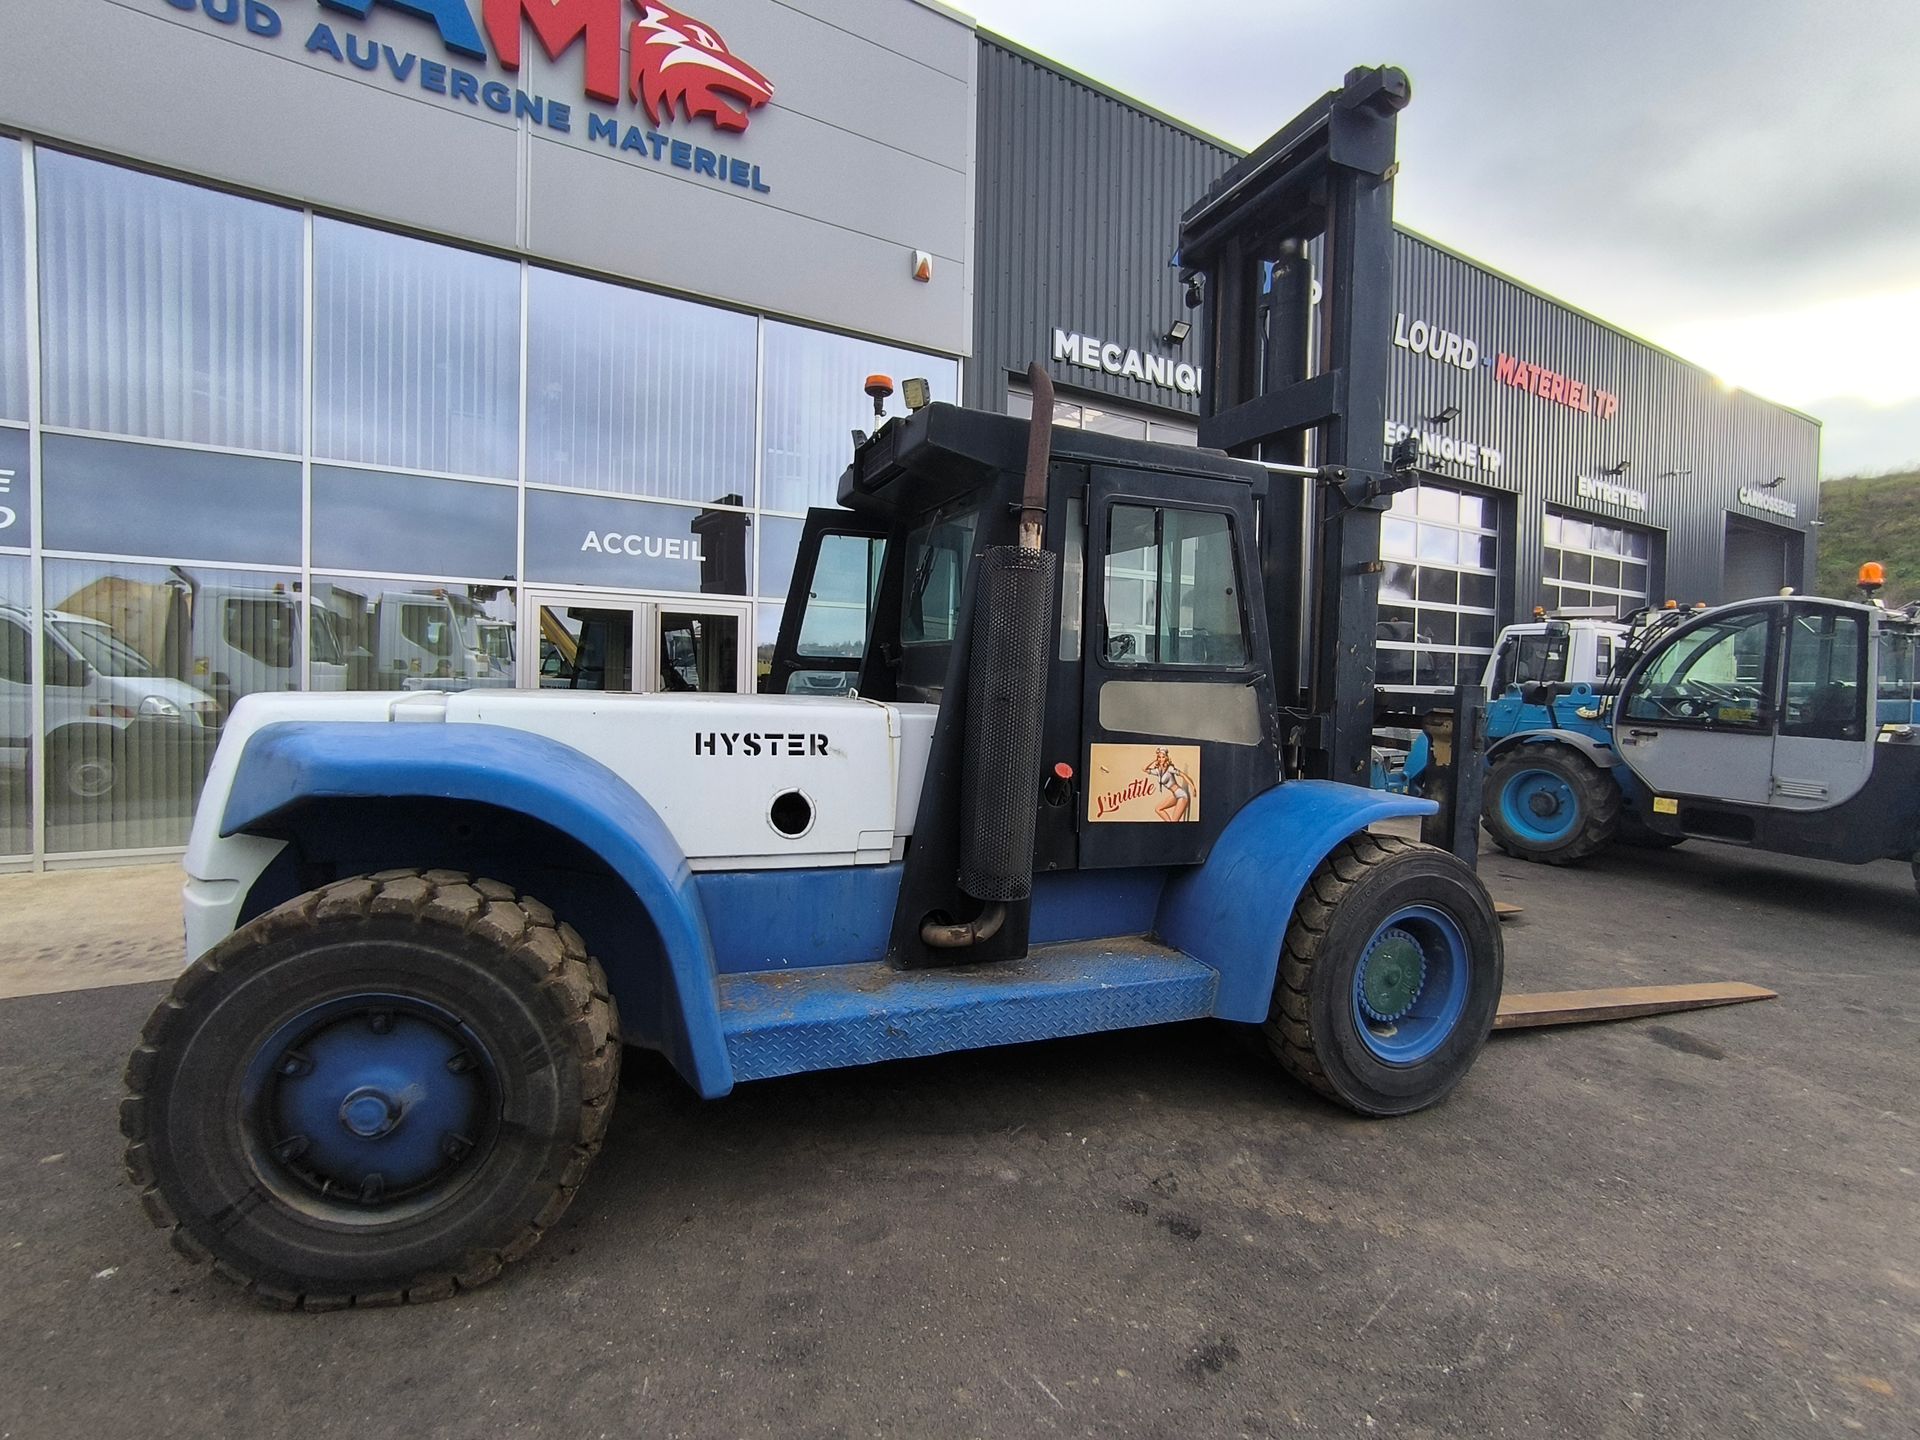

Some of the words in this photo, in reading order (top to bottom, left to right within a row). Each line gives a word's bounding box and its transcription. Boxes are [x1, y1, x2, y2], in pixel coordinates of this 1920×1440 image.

[305, 22, 571, 132] AUVERGNE
[588, 111, 771, 194] MATERIEL
[1394, 312, 1478, 370] LOURD
[1495, 352, 1589, 413] MATERIEL
[1595, 389, 1617, 420] TP
[1479, 446, 1502, 473] TP
[1578, 475, 1648, 512] ENTRETIEN
[581, 530, 707, 562] ACCUEIL
[695, 732, 829, 756] HYSTER
[1097, 777, 1156, 818] L'inutile
